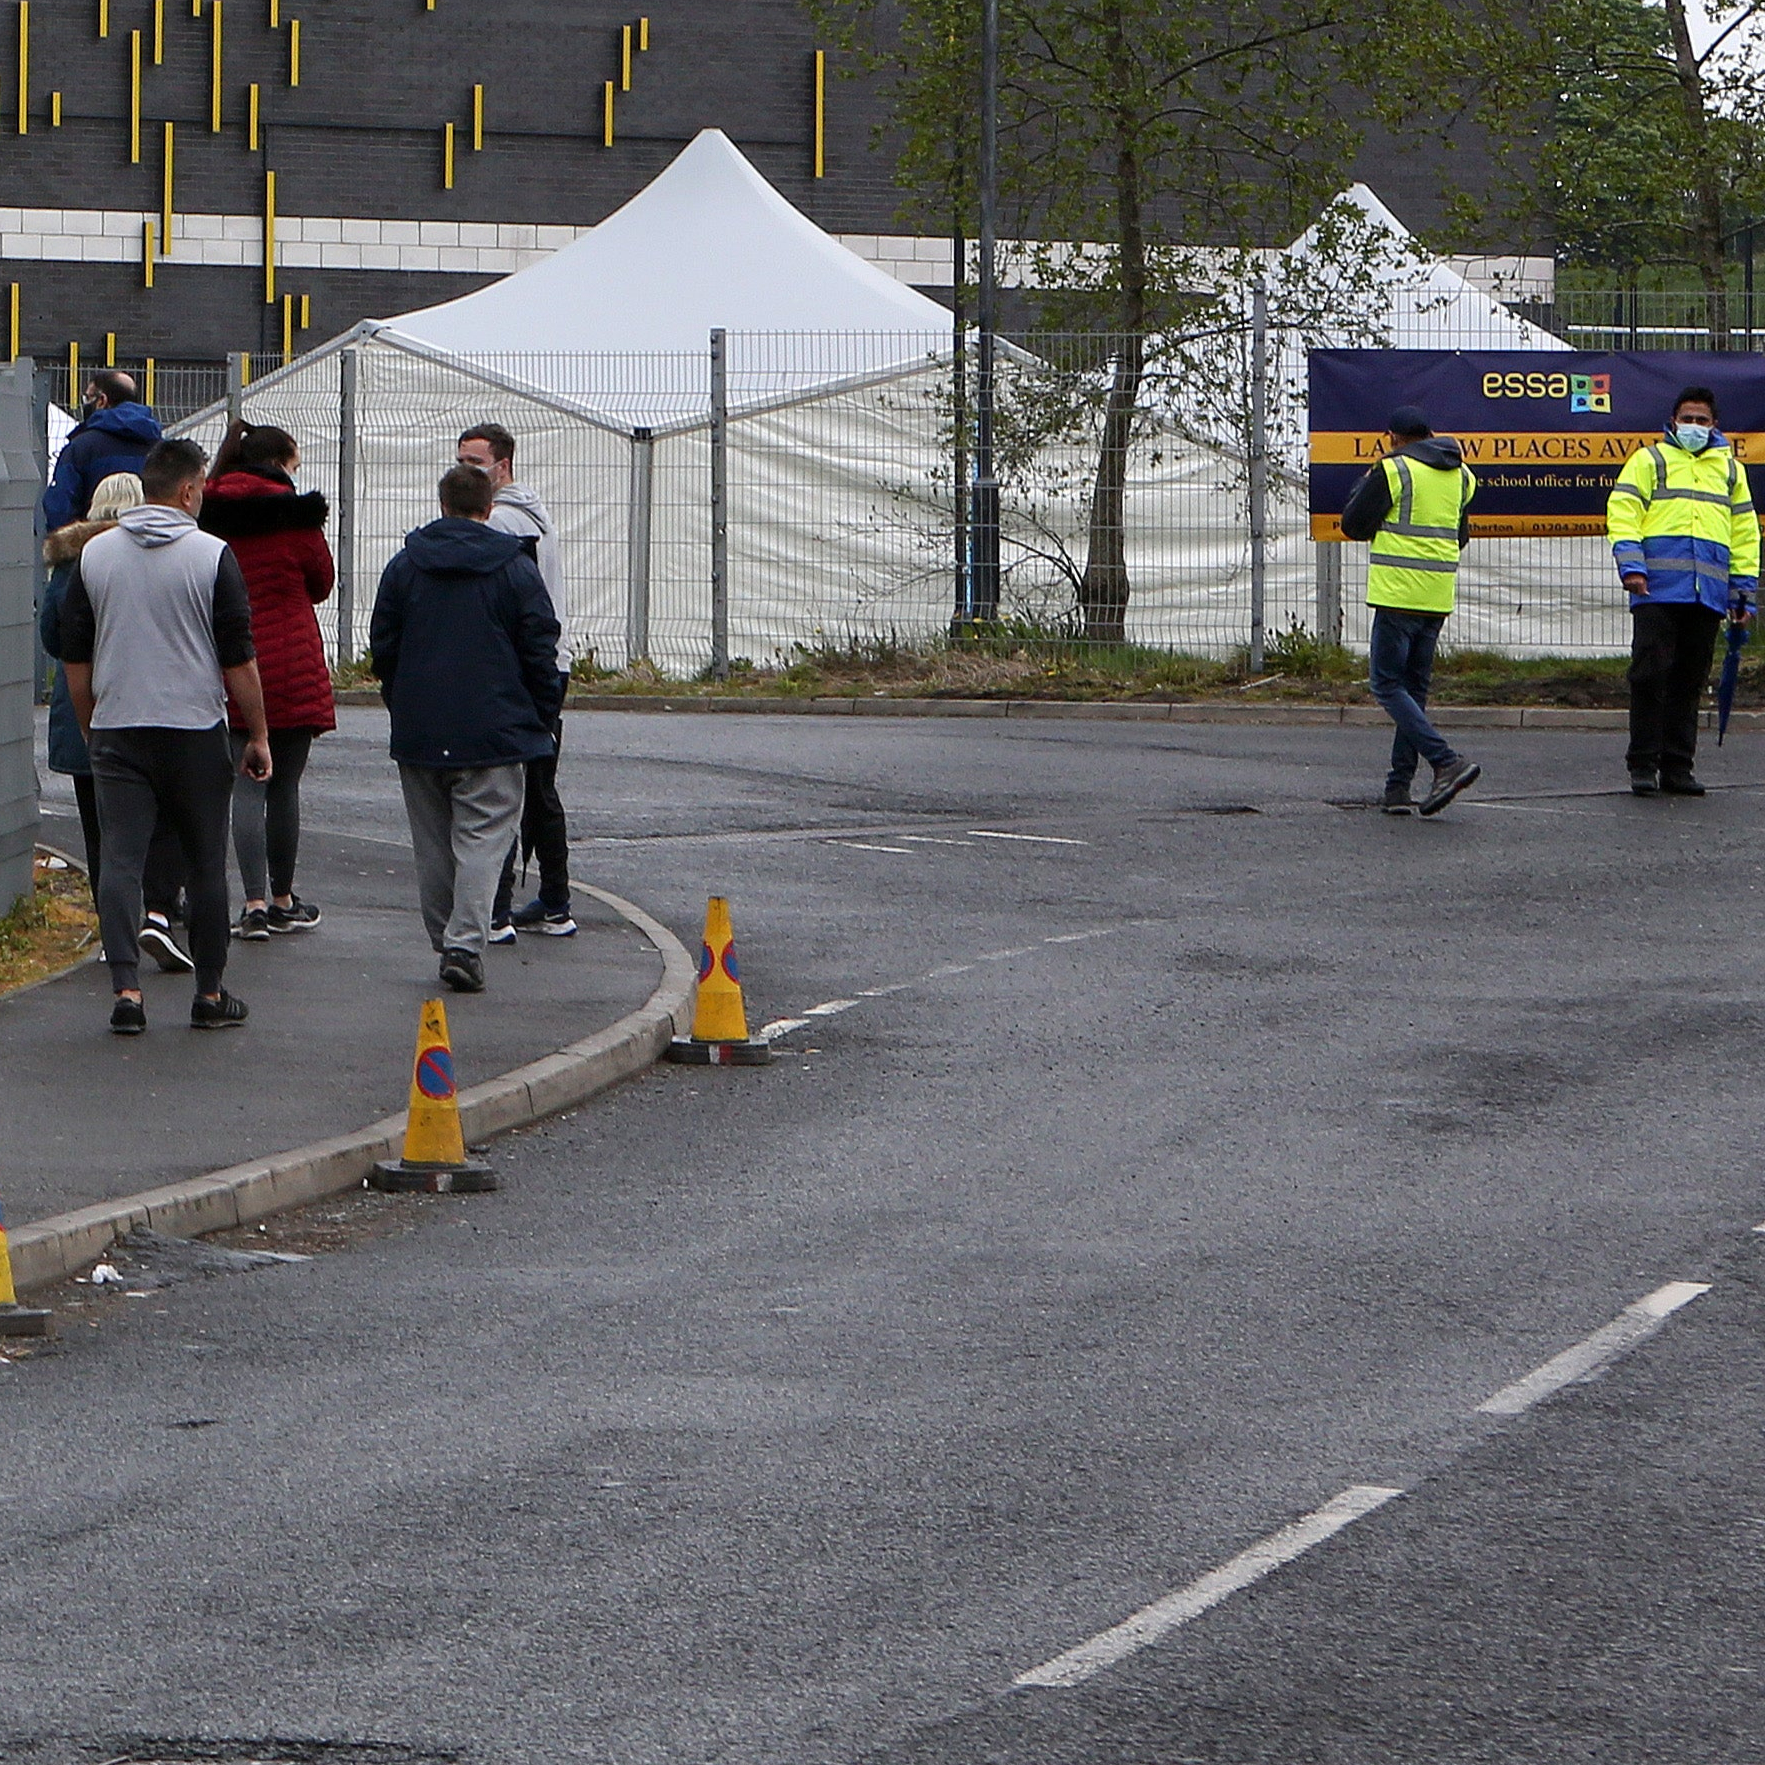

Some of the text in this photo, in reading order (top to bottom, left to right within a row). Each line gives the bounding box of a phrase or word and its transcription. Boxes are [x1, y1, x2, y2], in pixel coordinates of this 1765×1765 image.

[1481, 371, 1569, 399] essa
[1493, 438, 1591, 459] PLACES
[1487, 473, 1531, 488] school
[1535, 473, 1571, 488] office
[1575, 473, 1596, 488] for
[1468, 523, 1514, 532] therton
[1572, 522, 1607, 533] 20131
